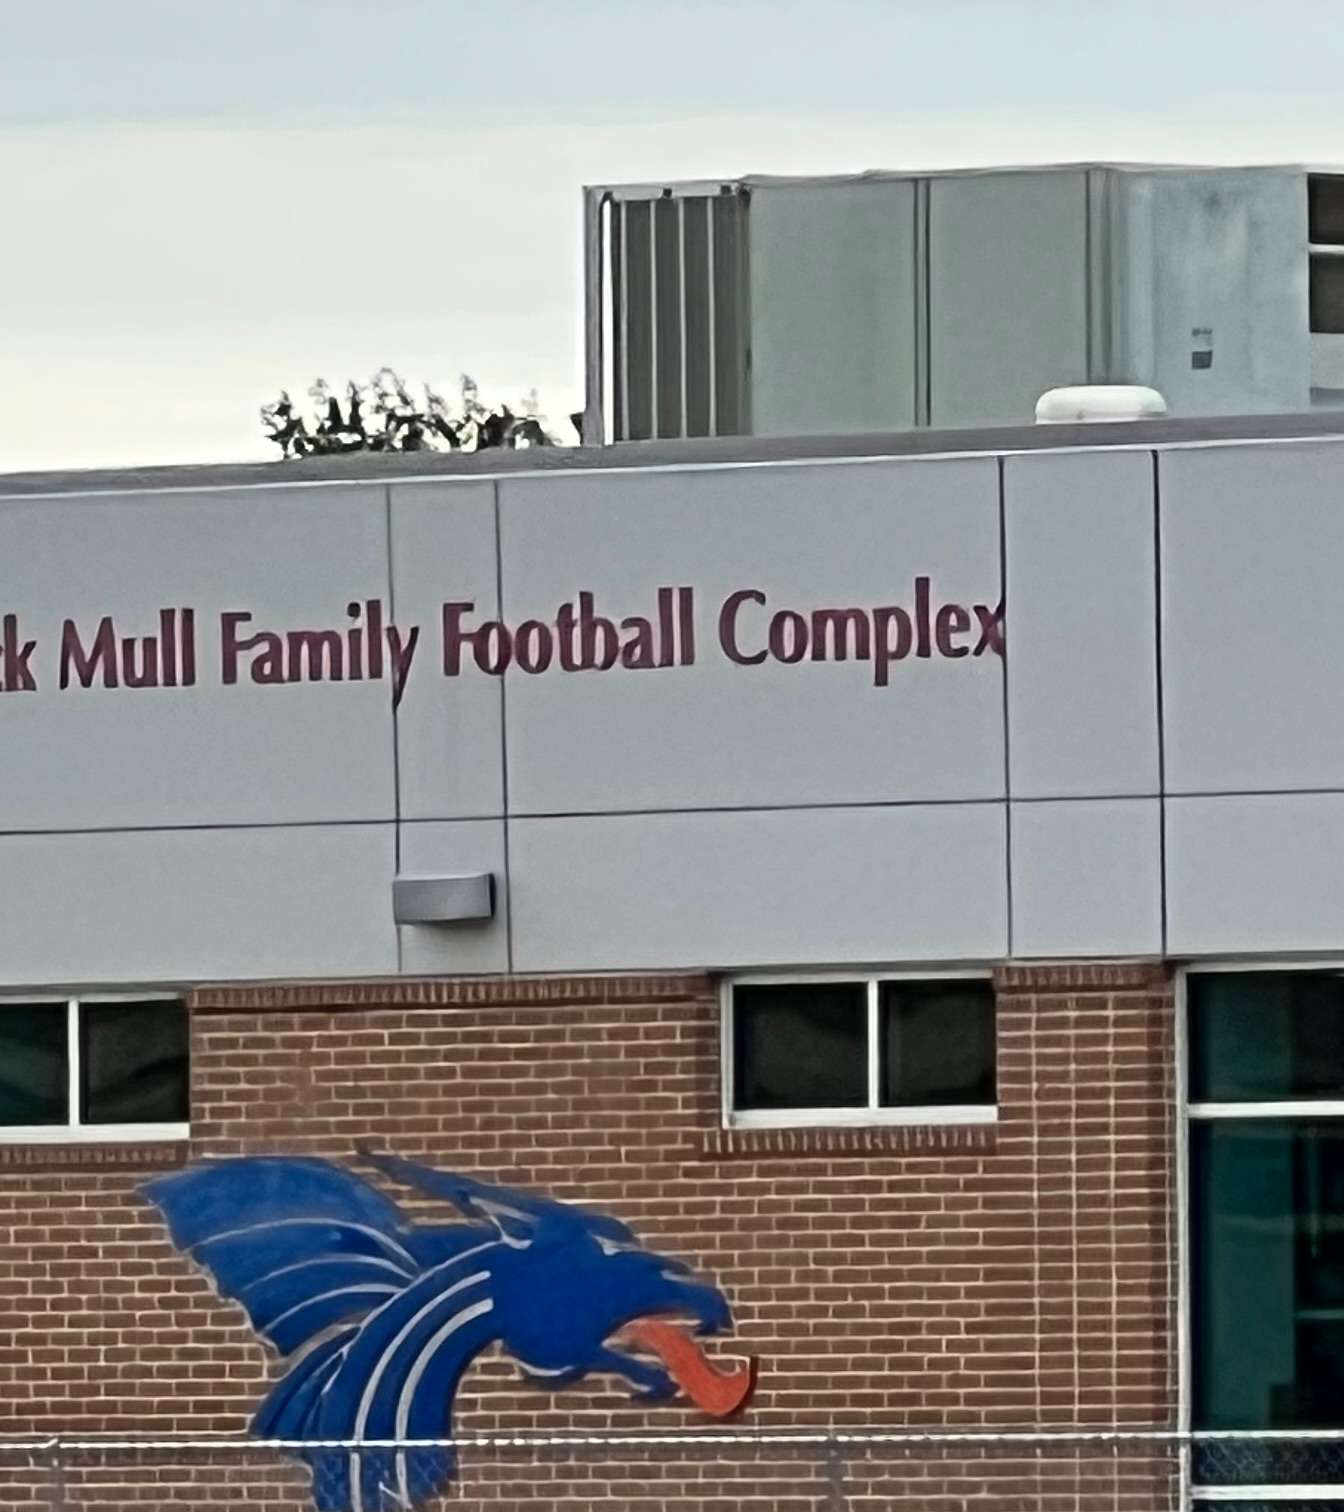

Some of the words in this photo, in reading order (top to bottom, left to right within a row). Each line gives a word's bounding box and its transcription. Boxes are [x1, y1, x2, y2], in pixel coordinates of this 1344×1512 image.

[60, 607, 196, 690] Mull
[221, 599, 418, 710] Family
[443, 587, 695, 676] Football
[720, 576, 1007, 686] Complex
